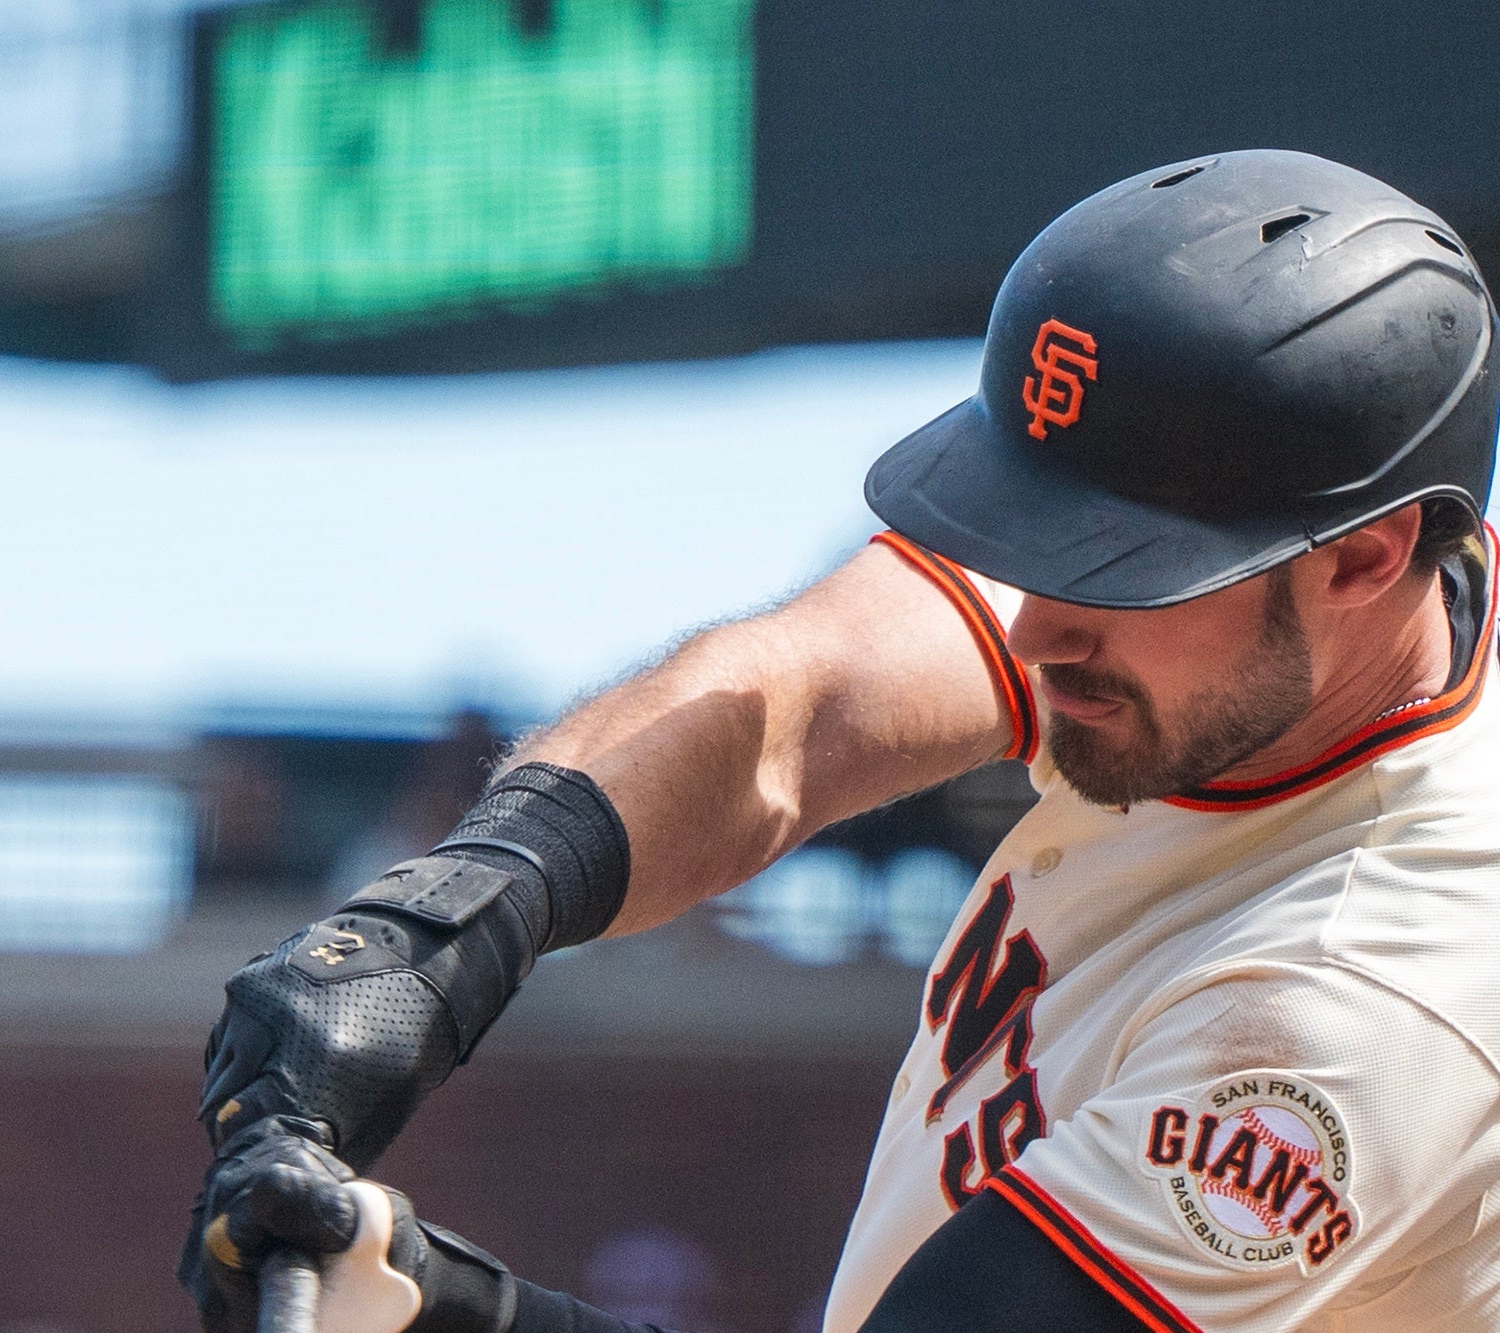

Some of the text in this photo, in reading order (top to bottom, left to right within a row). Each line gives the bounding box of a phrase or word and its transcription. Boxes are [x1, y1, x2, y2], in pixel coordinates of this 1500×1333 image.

[1211, 1081, 1347, 1182] SAN FRANCISCO
[1146, 1105, 1353, 1266] GIANTS
[1170, 1175, 1294, 1262] BASEBALL CLUB
